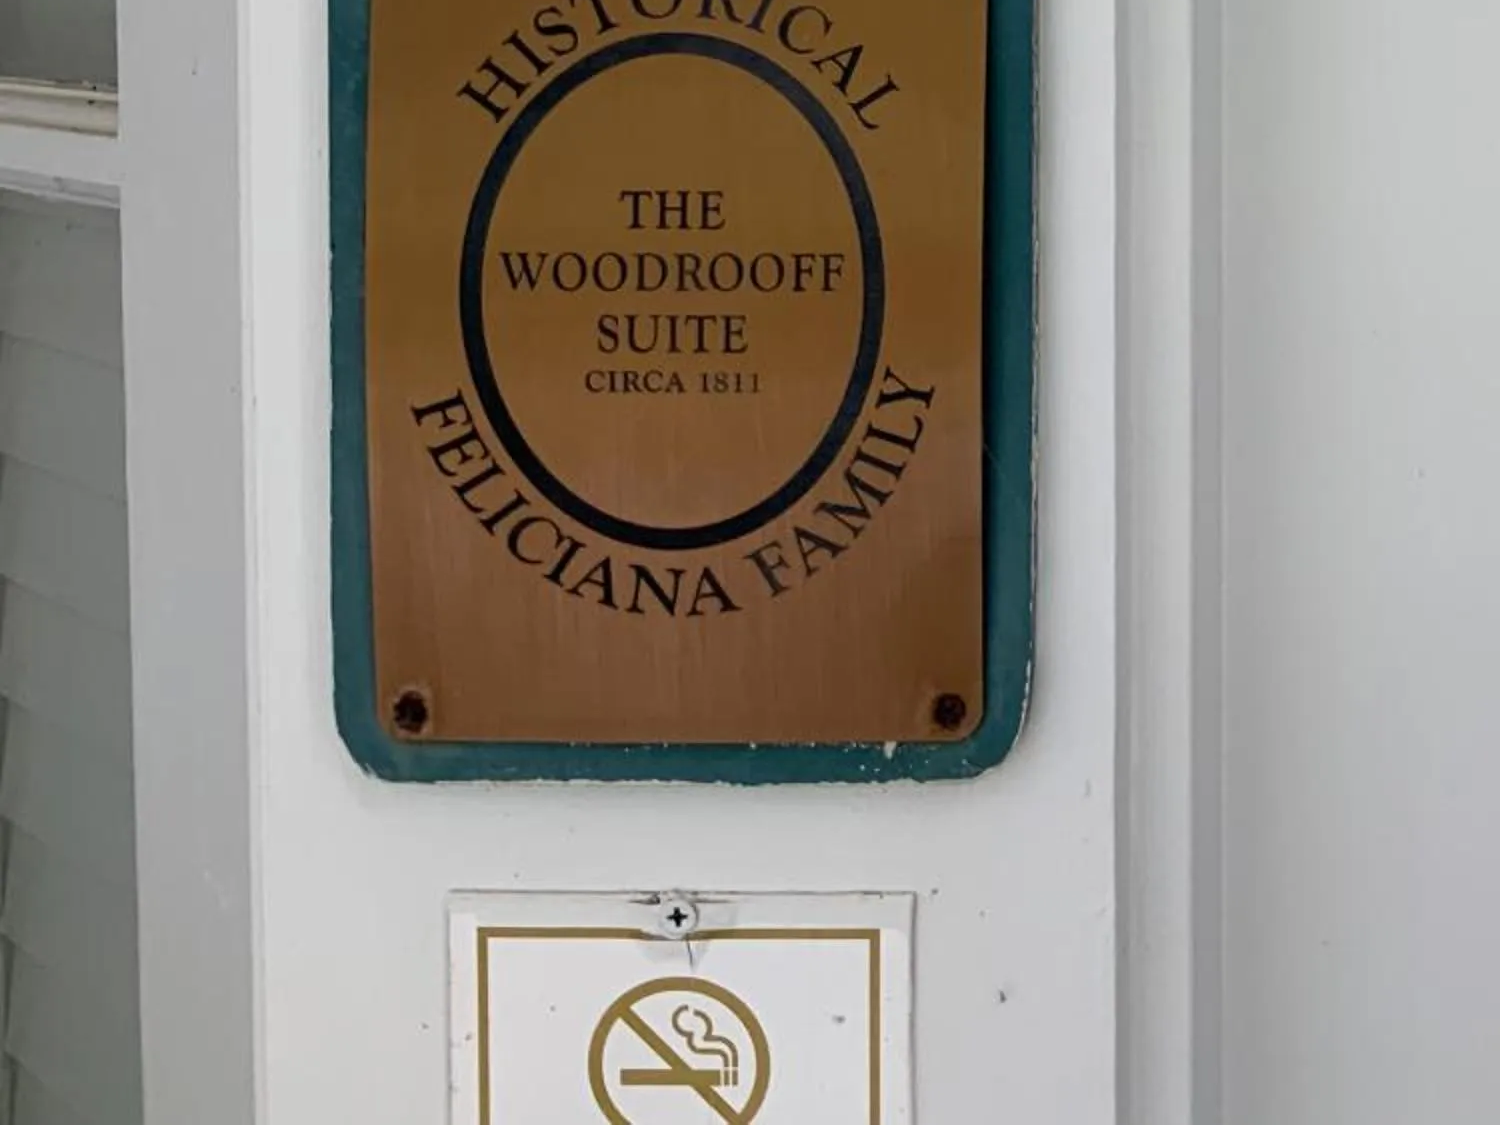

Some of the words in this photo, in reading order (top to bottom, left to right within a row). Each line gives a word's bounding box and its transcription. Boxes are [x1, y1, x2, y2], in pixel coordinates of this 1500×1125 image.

[618, 189, 725, 231] THE
[499, 251, 846, 294] WOODROOFF
[596, 314, 749, 355] SUITE
[583, 370, 687, 395] CIRCA
[697, 370, 762, 395] 1811
[410, 388, 742, 618] FELICIANA
[742, 365, 936, 599] FAMILY
